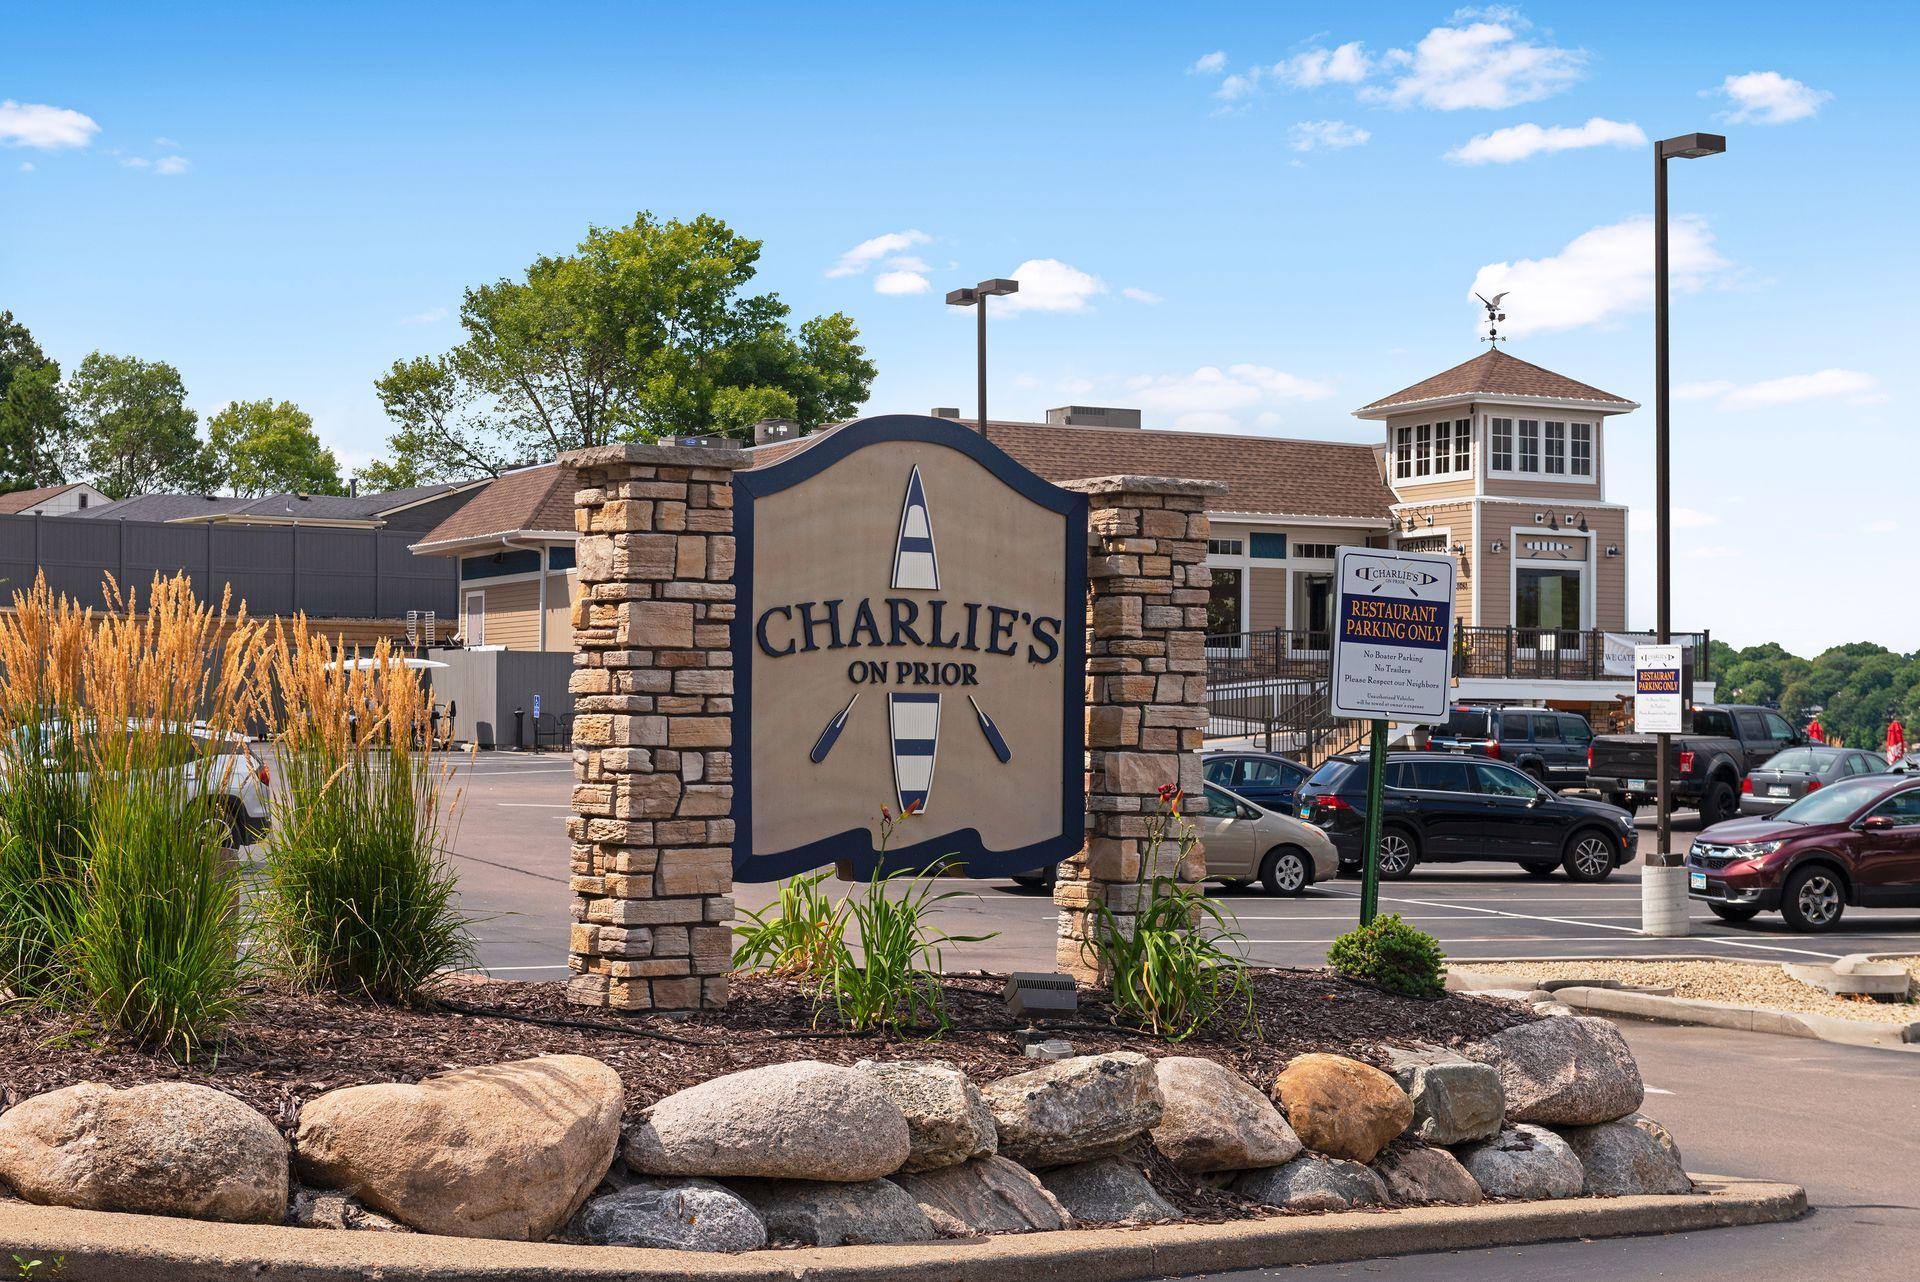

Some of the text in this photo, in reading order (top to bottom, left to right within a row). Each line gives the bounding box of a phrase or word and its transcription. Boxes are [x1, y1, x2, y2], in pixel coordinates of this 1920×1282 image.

[1372, 569, 1419, 582] CHARLIE'S
[1351, 600, 1437, 622] RESTAURANT
[756, 597, 1062, 664] CHARLIE'S
[1346, 618, 1443, 642] PARKING ONLY
[1363, 650, 1424, 663] No Boater Parking
[848, 660, 979, 685] ON PRIOR
[1374, 663, 1411, 674] No Trailers
[1344, 674, 1366, 684] Please
[1367, 676, 1393, 686] Respect
[1406, 679, 1439, 689] Neighbors
[1640, 671, 1675, 681] RESTAURANT
[1638, 681, 1678, 691] PARKING ONLY
